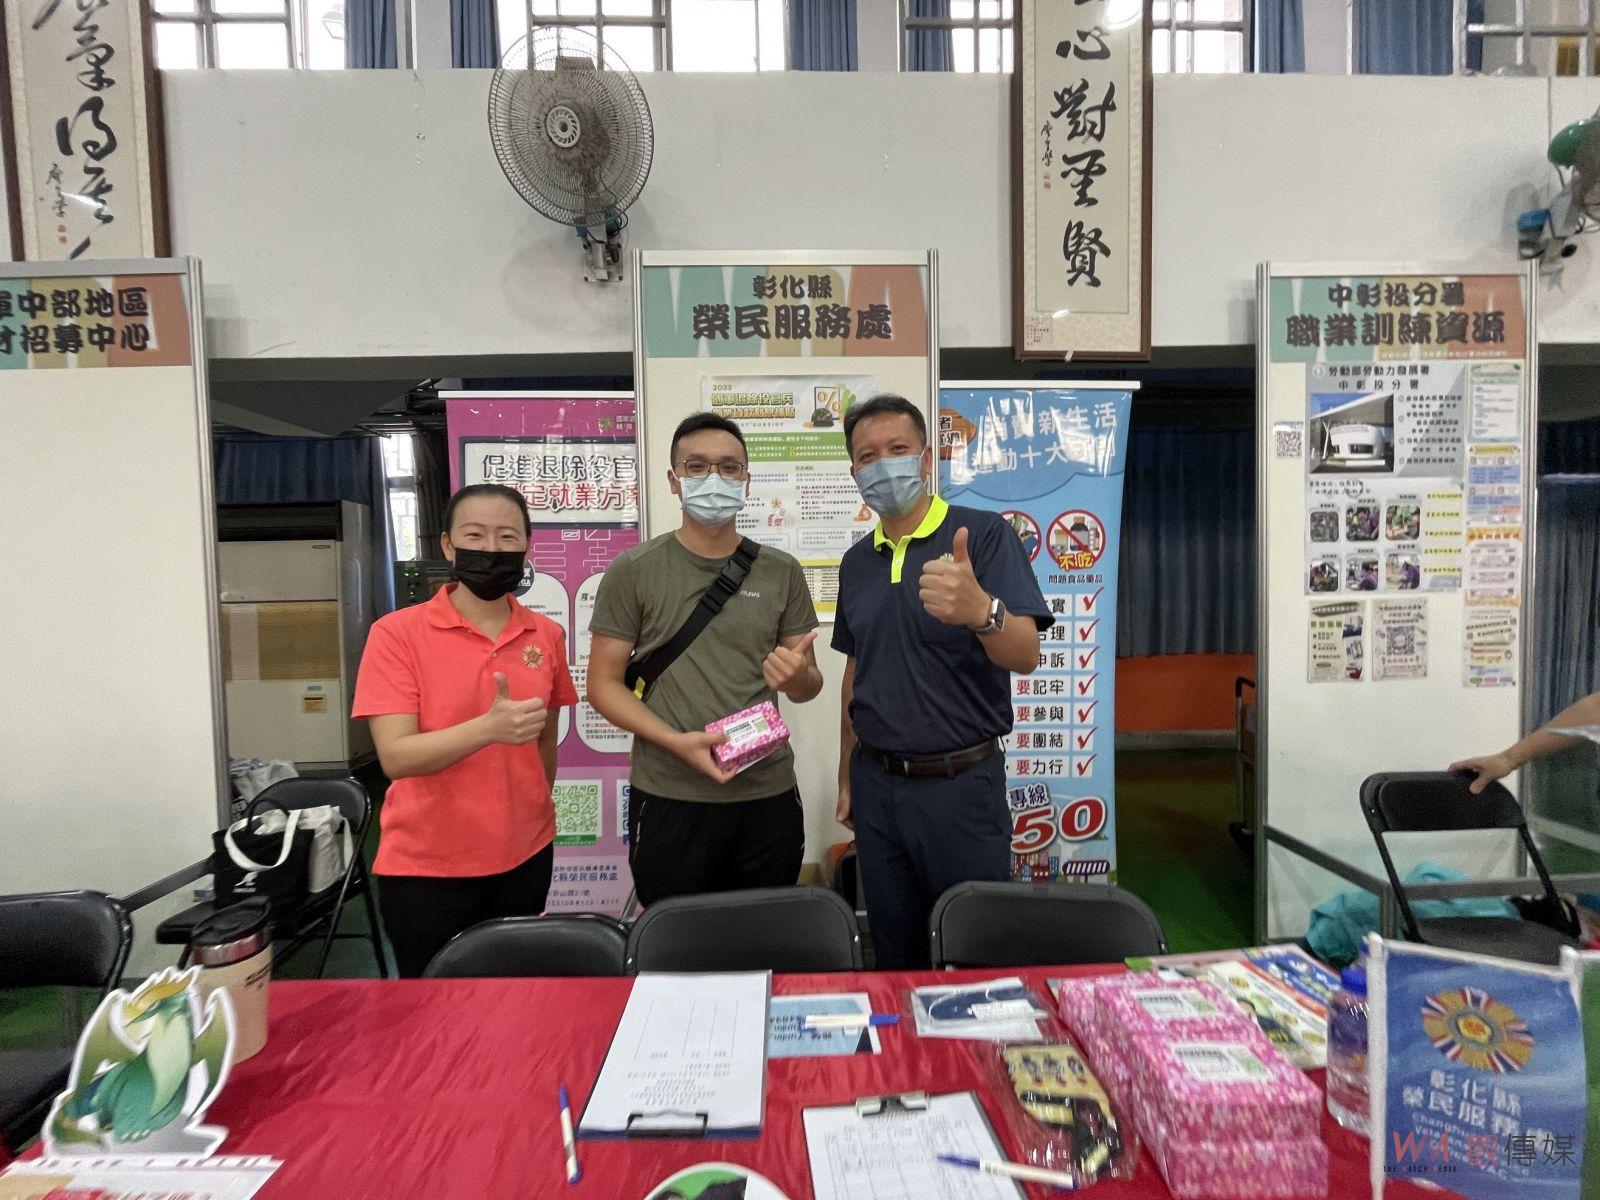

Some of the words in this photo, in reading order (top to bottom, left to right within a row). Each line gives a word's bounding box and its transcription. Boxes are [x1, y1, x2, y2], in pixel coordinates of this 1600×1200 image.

[1054, 0, 1117, 288] 心對聖賢
[752, 274, 832, 299] 彰化縣
[1329, 282, 1465, 307] 中彰投分署
[692, 303, 893, 340] 榮民服務處
[1286, 311, 1505, 347] 職業訓練資源
[1058, 551, 1096, 571] 不吃
[1016, 679, 1064, 695] 要記牢
[1016, 706, 1064, 722] 要參與
[1016, 733, 1064, 748] 要團結
[1016, 759, 1064, 775] 要力行
